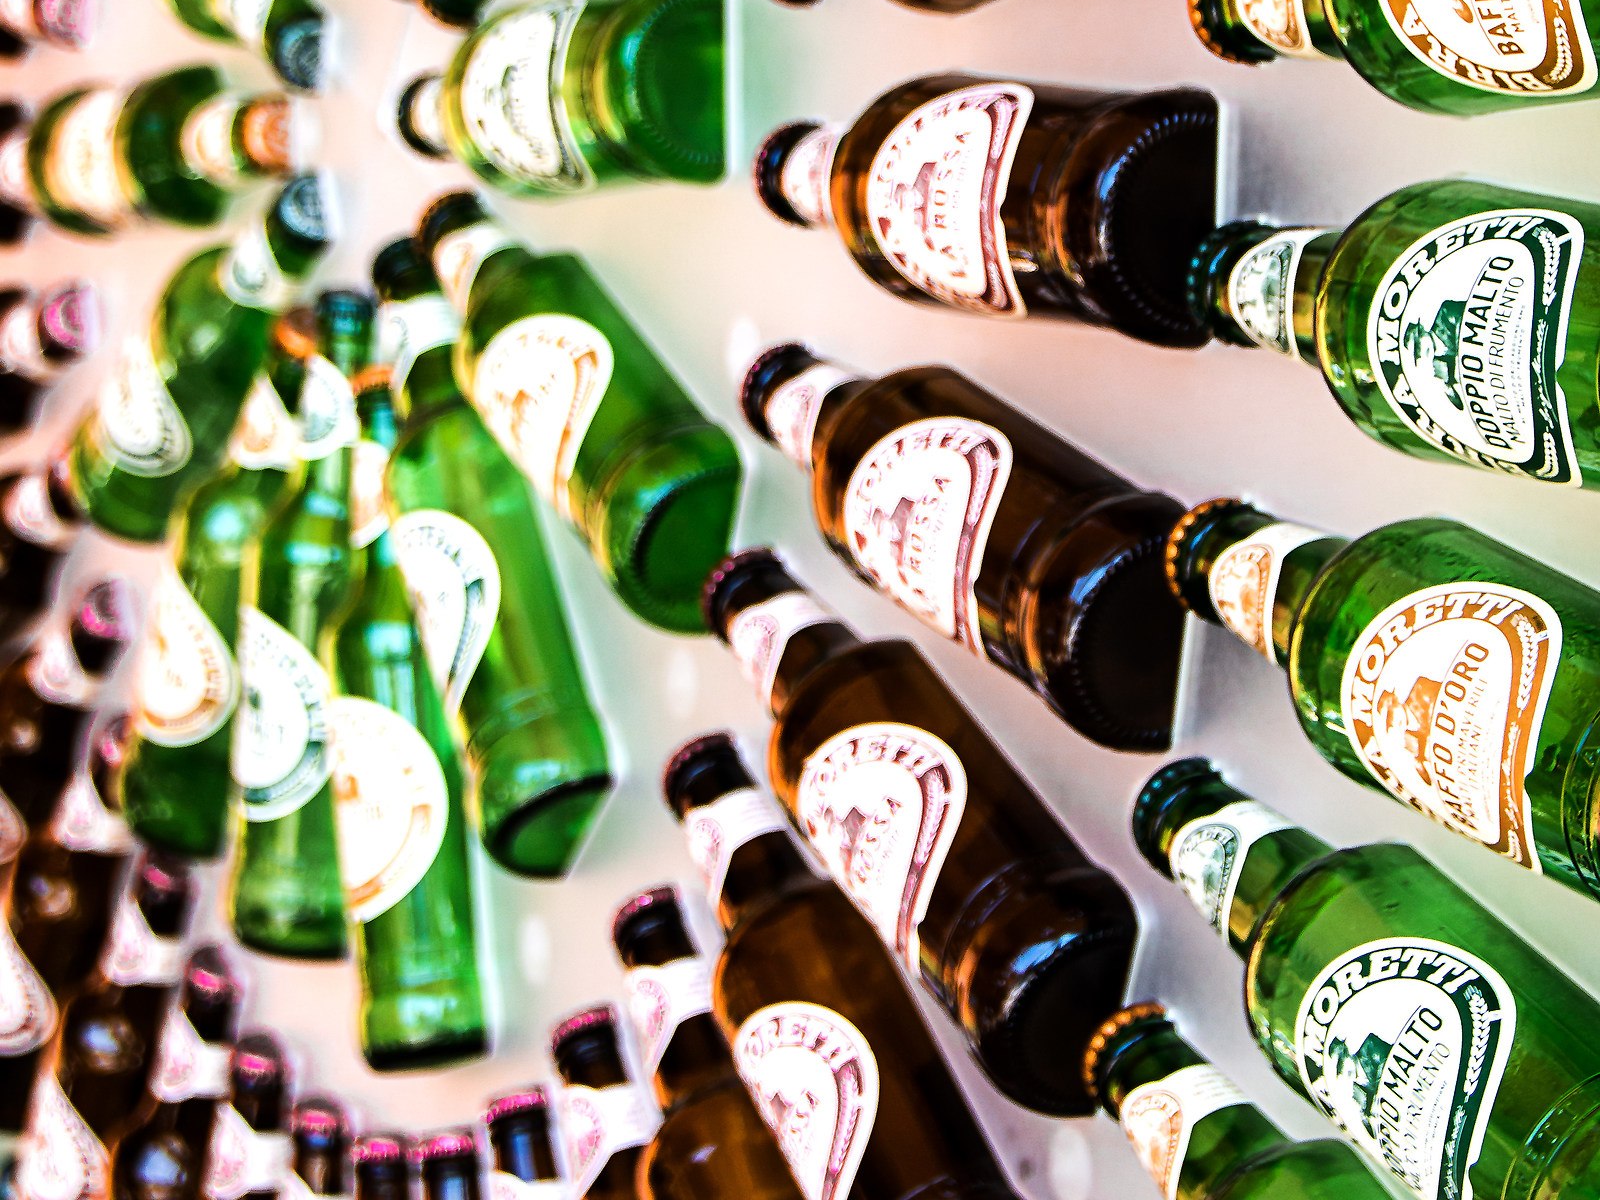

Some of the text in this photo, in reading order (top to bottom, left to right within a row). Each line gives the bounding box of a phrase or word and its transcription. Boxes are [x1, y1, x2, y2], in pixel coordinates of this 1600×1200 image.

[1402, 2, 1554, 91] BIRRA
[1377, 216, 1545, 366] MORETTI
[1488, 275, 1526, 368] FRUMENTO
[1461, 256, 1515, 451] DOPPIO MALTO
[1488, 370, 1505, 391] DI
[1492, 394, 1527, 445] MALTO
[1351, 592, 1525, 729] MORETTI
[1434, 642, 1490, 736] D'ORO
[1302, 947, 1481, 1069] MORETTI
[1383, 1007, 1443, 1100] MALTO
